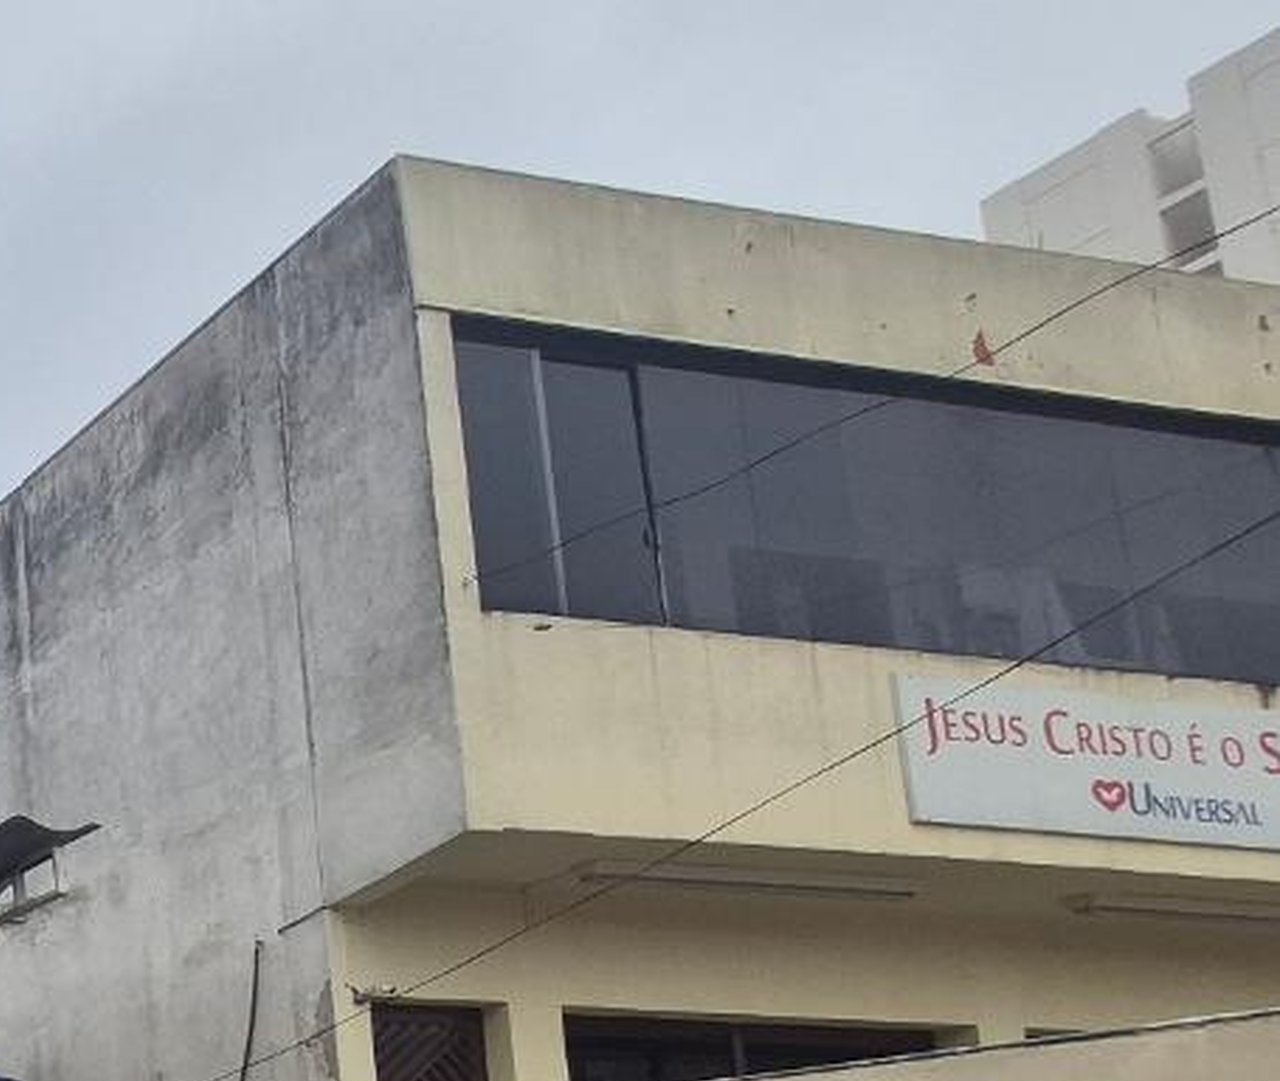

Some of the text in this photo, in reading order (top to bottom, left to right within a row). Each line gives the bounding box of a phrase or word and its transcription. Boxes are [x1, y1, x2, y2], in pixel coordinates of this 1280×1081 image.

[925, 697, 1029, 756] JESUS
[1043, 709, 1173, 761] CRISTO
[1187, 722, 1206, 765] É
[1221, 736, 1245, 768] O
[1128, 781, 1263, 827] UNIVERSAL
